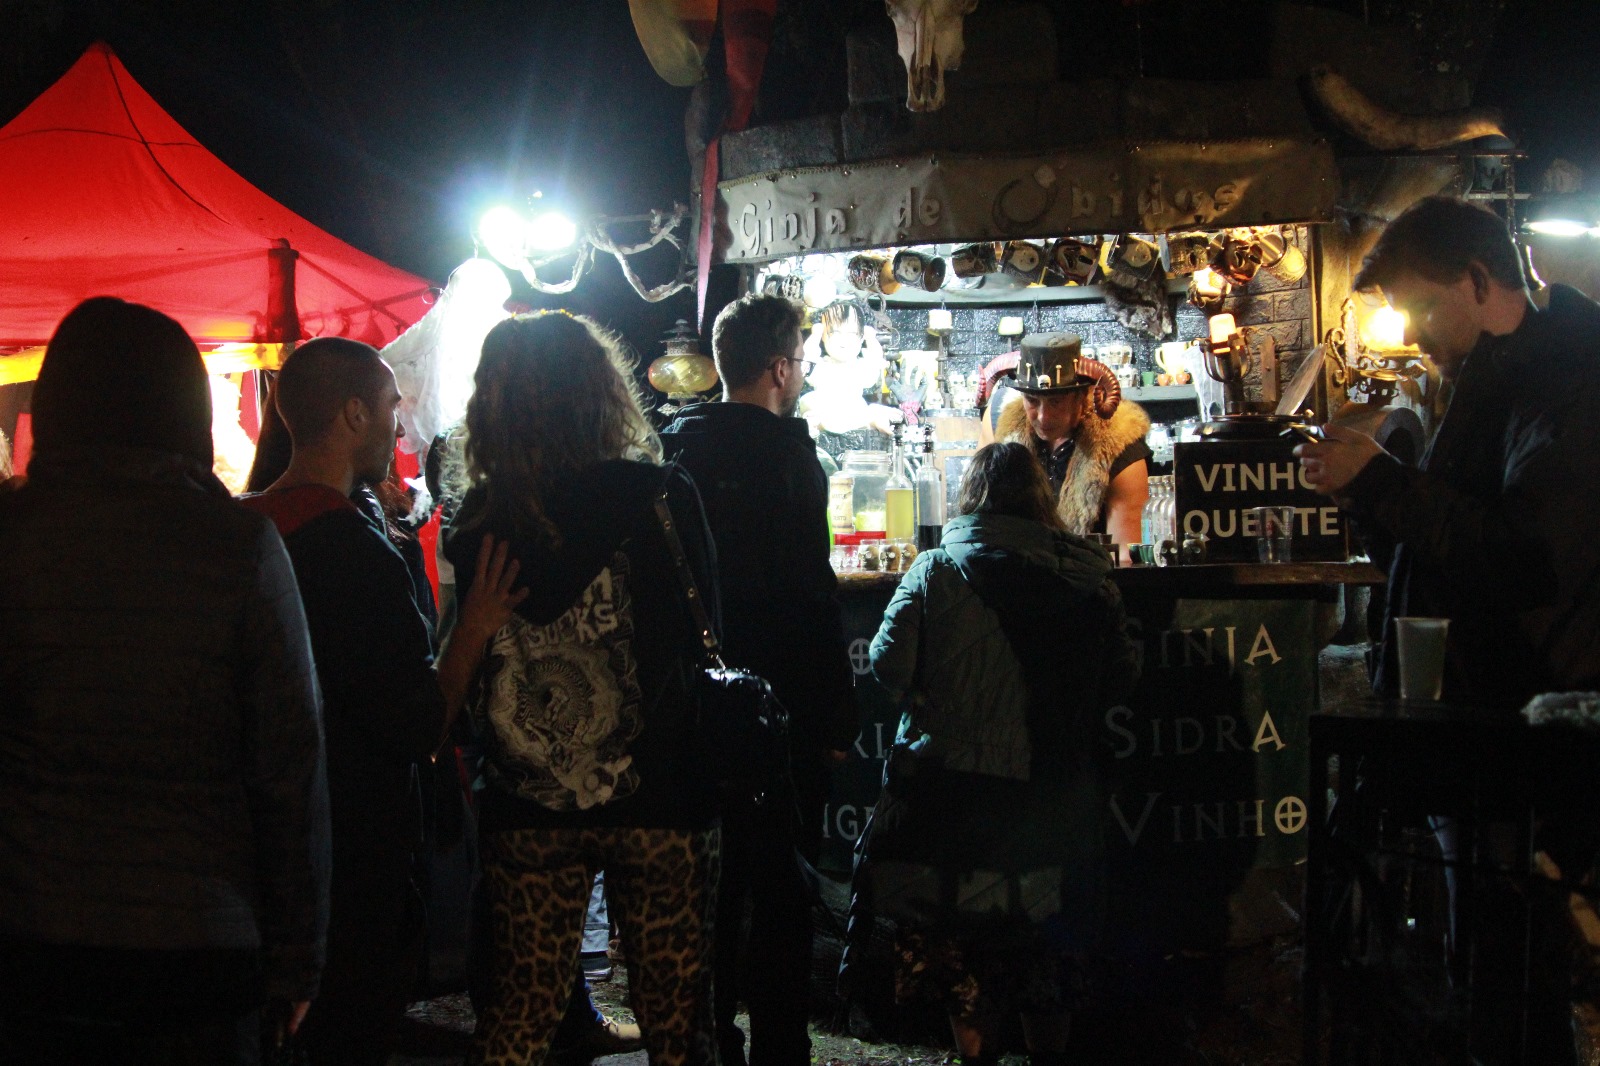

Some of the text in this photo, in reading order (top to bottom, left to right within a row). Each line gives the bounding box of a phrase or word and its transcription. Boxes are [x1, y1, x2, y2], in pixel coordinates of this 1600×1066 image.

[739, 191, 847, 256] Ginja
[893, 187, 941, 228] de
[1183, 507, 1340, 540] QUENTE
